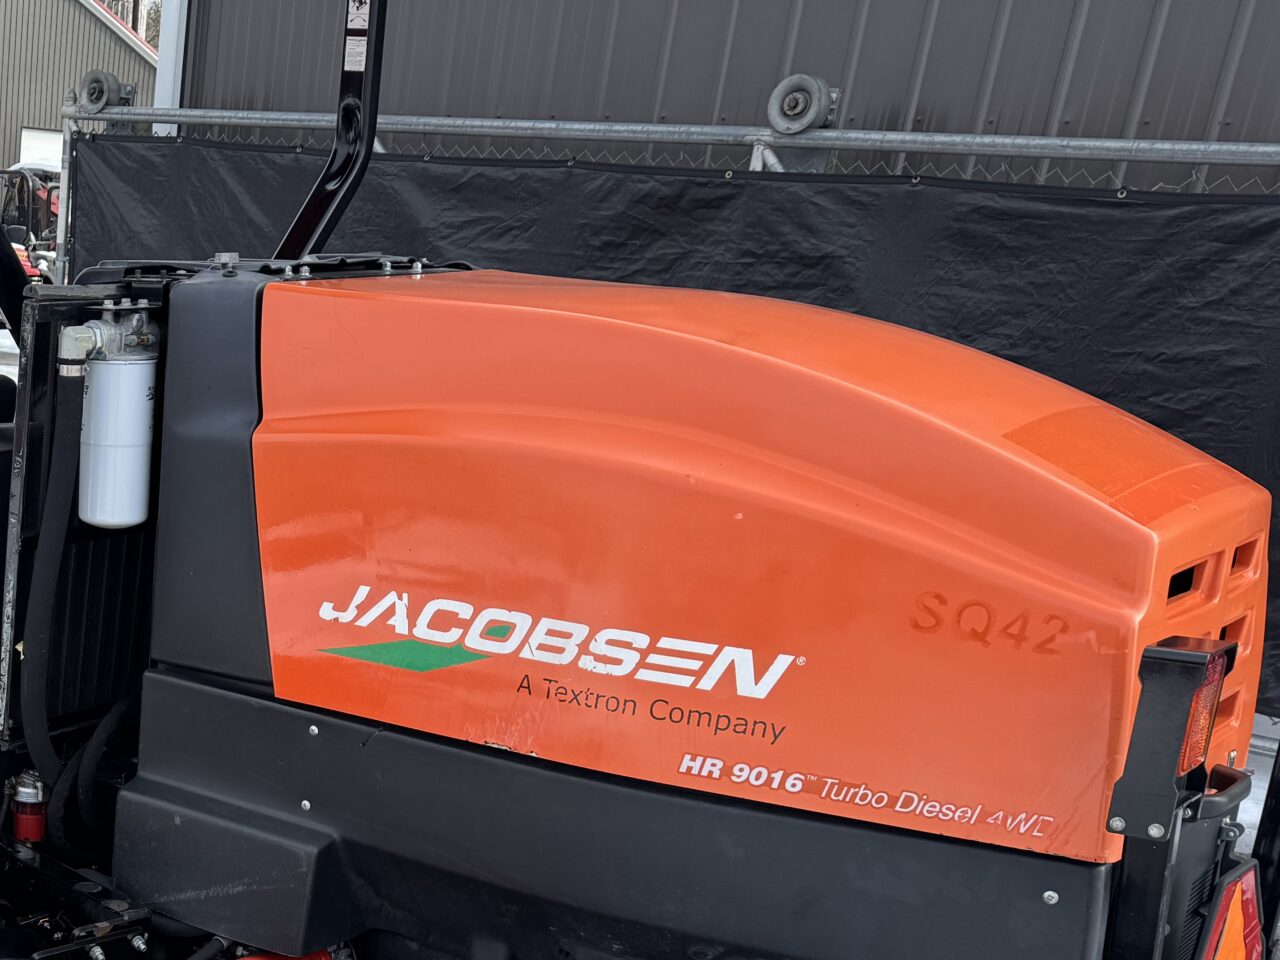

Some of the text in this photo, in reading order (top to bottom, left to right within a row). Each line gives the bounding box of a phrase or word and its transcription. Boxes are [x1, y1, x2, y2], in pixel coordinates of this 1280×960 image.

[318, 585, 796, 699] JACOBSEN
[909, 591, 1069, 656] SQ42
[516, 674, 786, 745] A Textron Company
[678, 753, 724, 778] HR
[821, 778, 889, 808] Turbo
[894, 791, 983, 825] Diesel
